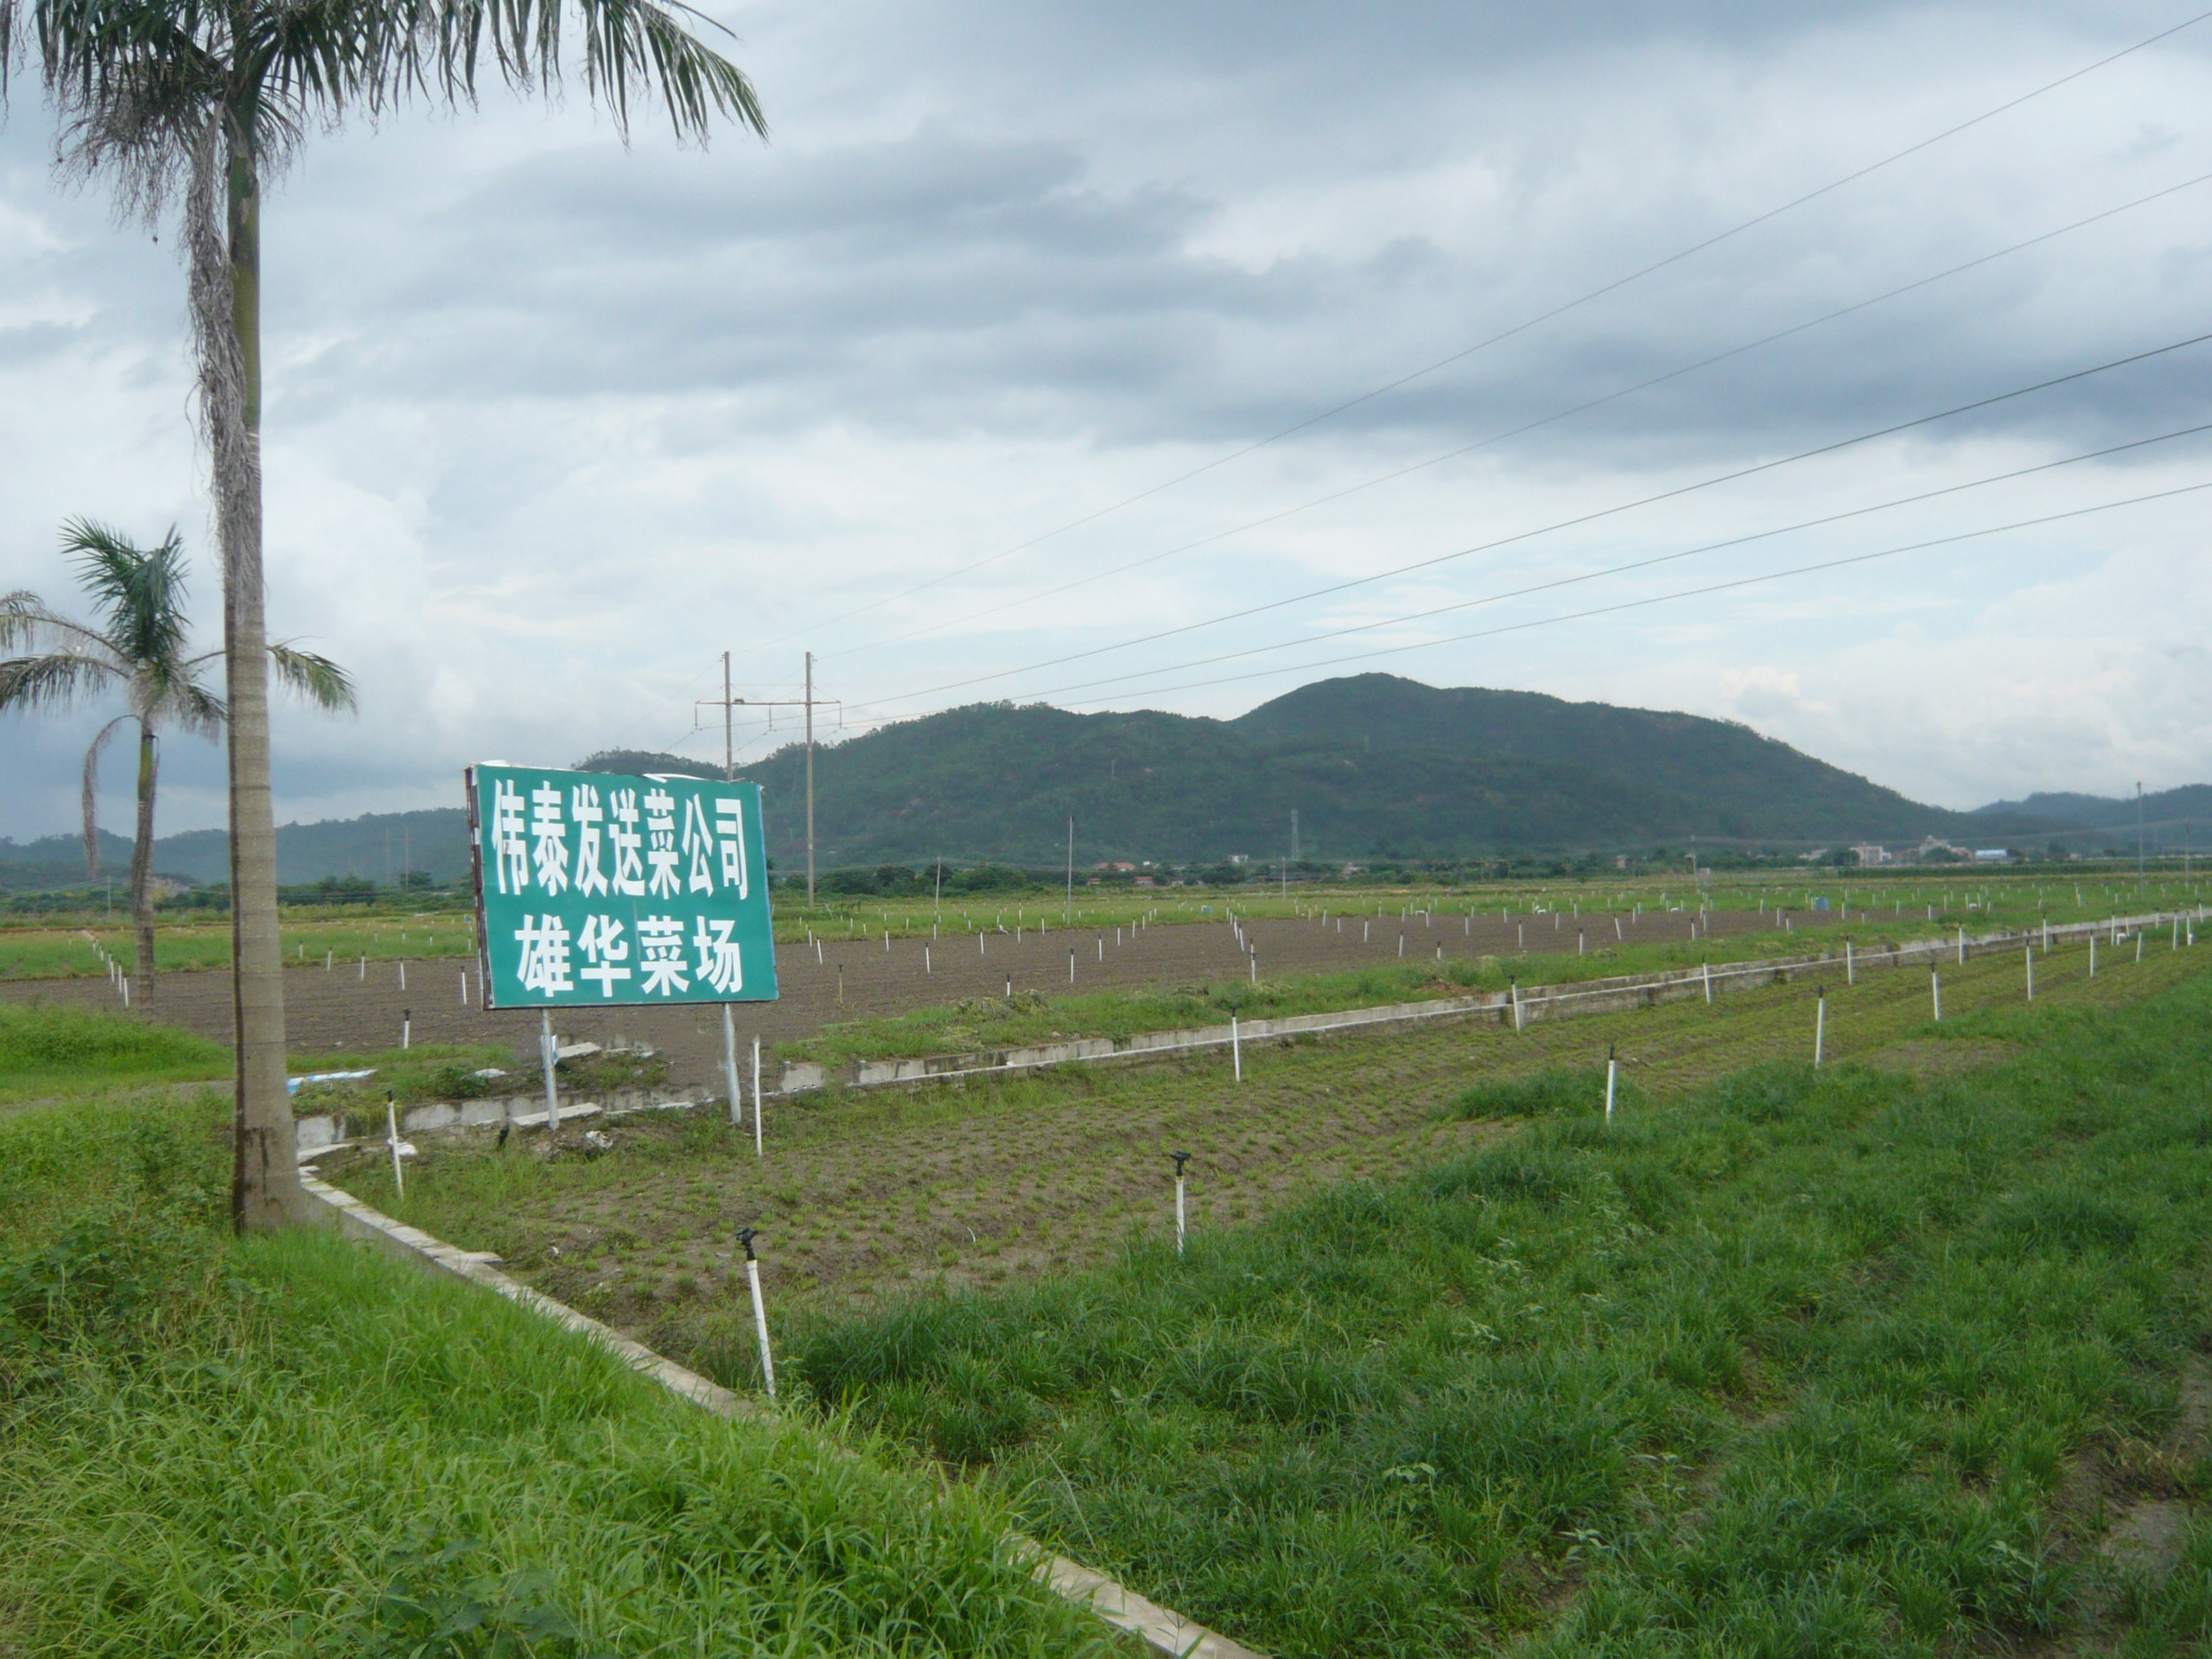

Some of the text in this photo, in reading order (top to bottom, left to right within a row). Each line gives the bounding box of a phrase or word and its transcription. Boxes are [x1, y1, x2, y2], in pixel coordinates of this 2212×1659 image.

[492, 779, 748, 899] 伟泰发送菜公司
[514, 912, 743, 997] 雄华菜场
